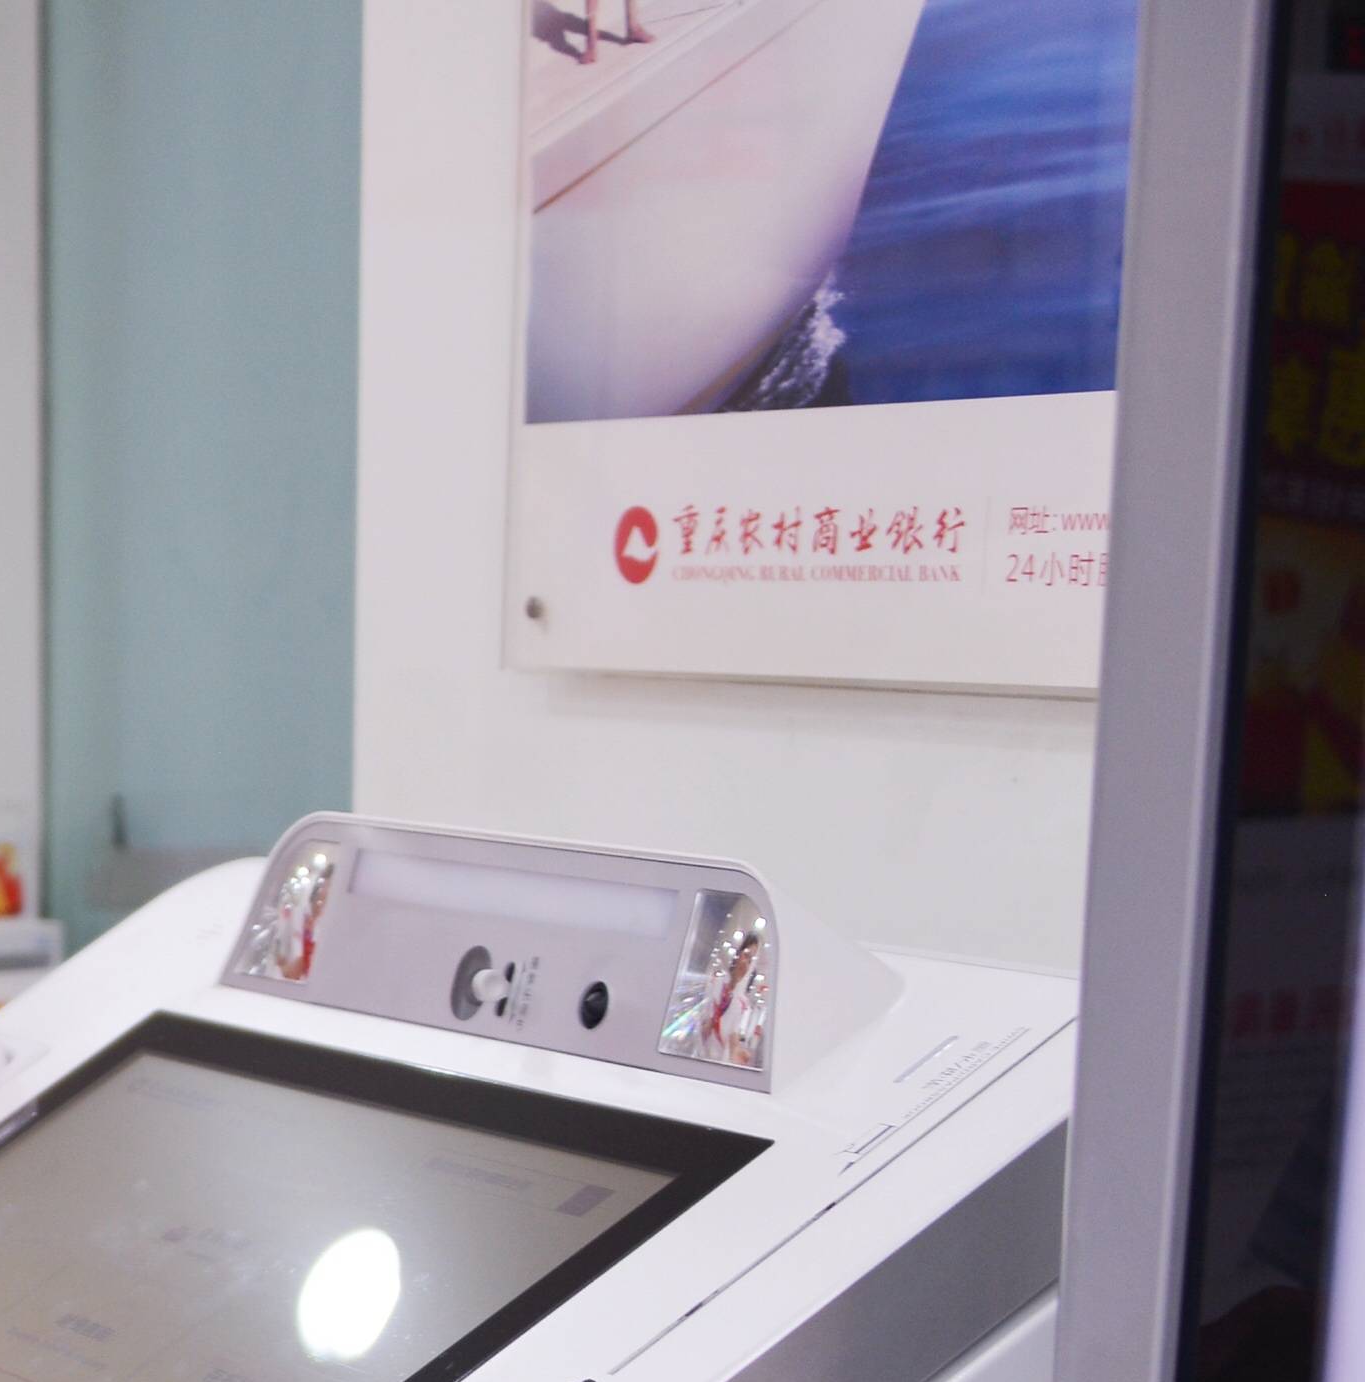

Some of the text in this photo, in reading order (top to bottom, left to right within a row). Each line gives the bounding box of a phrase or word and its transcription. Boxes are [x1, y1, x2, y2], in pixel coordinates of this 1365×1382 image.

[672, 503, 966, 555] 重庆农村商业银行
[810, 563, 915, 583] COMMERCIAL
[918, 563, 962, 582] BANK
